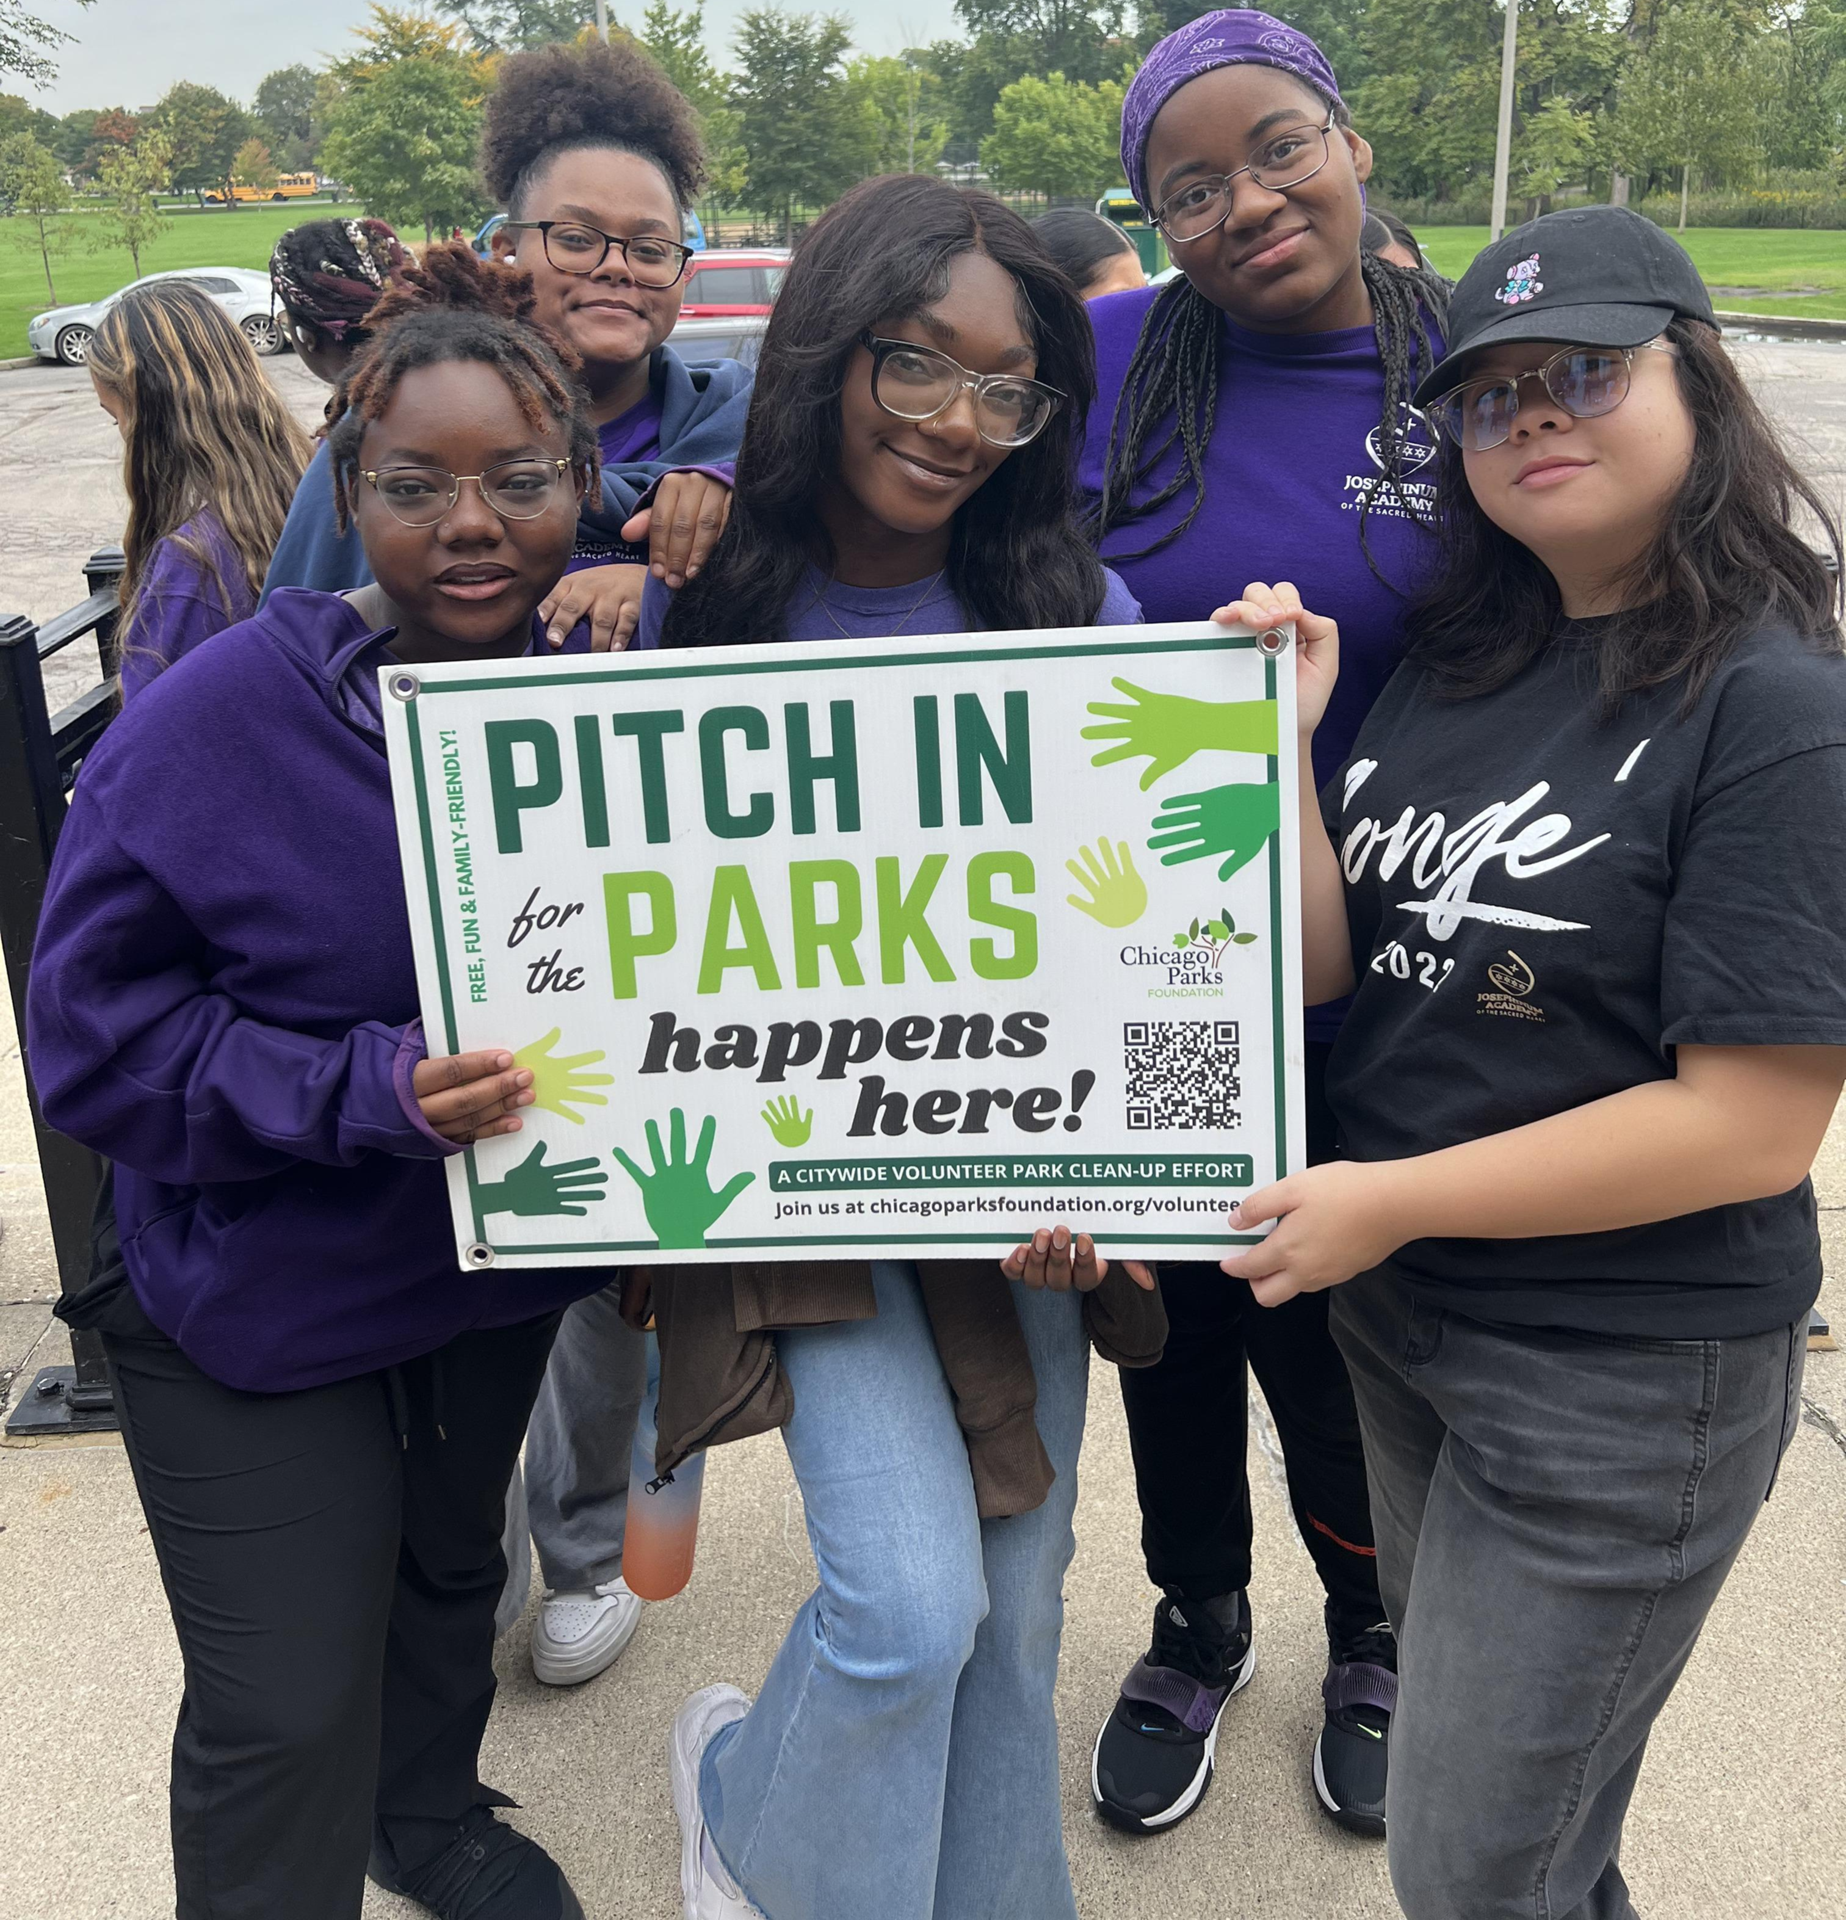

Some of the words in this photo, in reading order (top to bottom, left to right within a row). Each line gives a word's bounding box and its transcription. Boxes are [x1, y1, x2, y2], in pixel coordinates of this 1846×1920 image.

[1356, 505, 1373, 513] TE
[1417, 513, 1444, 522] HEAT
[573, 542, 631, 553] CADEMY
[615, 551, 639, 560] HEART
[484, 699, 861, 854] PITCH
[913, 690, 1033, 828] IN
[439, 729, 475, 896] FAMILY-FRIENDLY!
[460, 898, 477, 914] &
[507, 886, 584, 948] for
[462, 918, 482, 954] FUN
[603, 851, 1039, 999] PARKS
[1120, 946, 1210, 970] Chicago
[471, 957, 487, 1003] FREE,
[526, 949, 585, 994] the
[1166, 966, 1223, 985] Parks
[1148, 987, 1224, 998] FOUNDATION
[1499, 1010, 1524, 1018] SACRED
[638, 1011, 1050, 1083] happens
[847, 1069, 1096, 1137] here!
[777, 1169, 791, 1184] A
[796, 1166, 887, 1183] CITYWIDE
[892, 1164, 1007, 1181] VOLUNTEER
[1013, 1163, 1064, 1178] PARK
[1069, 1163, 1166, 1178] CLEAN-UP
[1172, 1162, 1245, 1178] EFFORT
[775, 1201, 812, 1219] Join
[818, 1202, 839, 1214] us
[845, 1200, 865, 1214] at
[870, 1196, 1243, 1217] chicagoparksfoundation.org/voluntee
